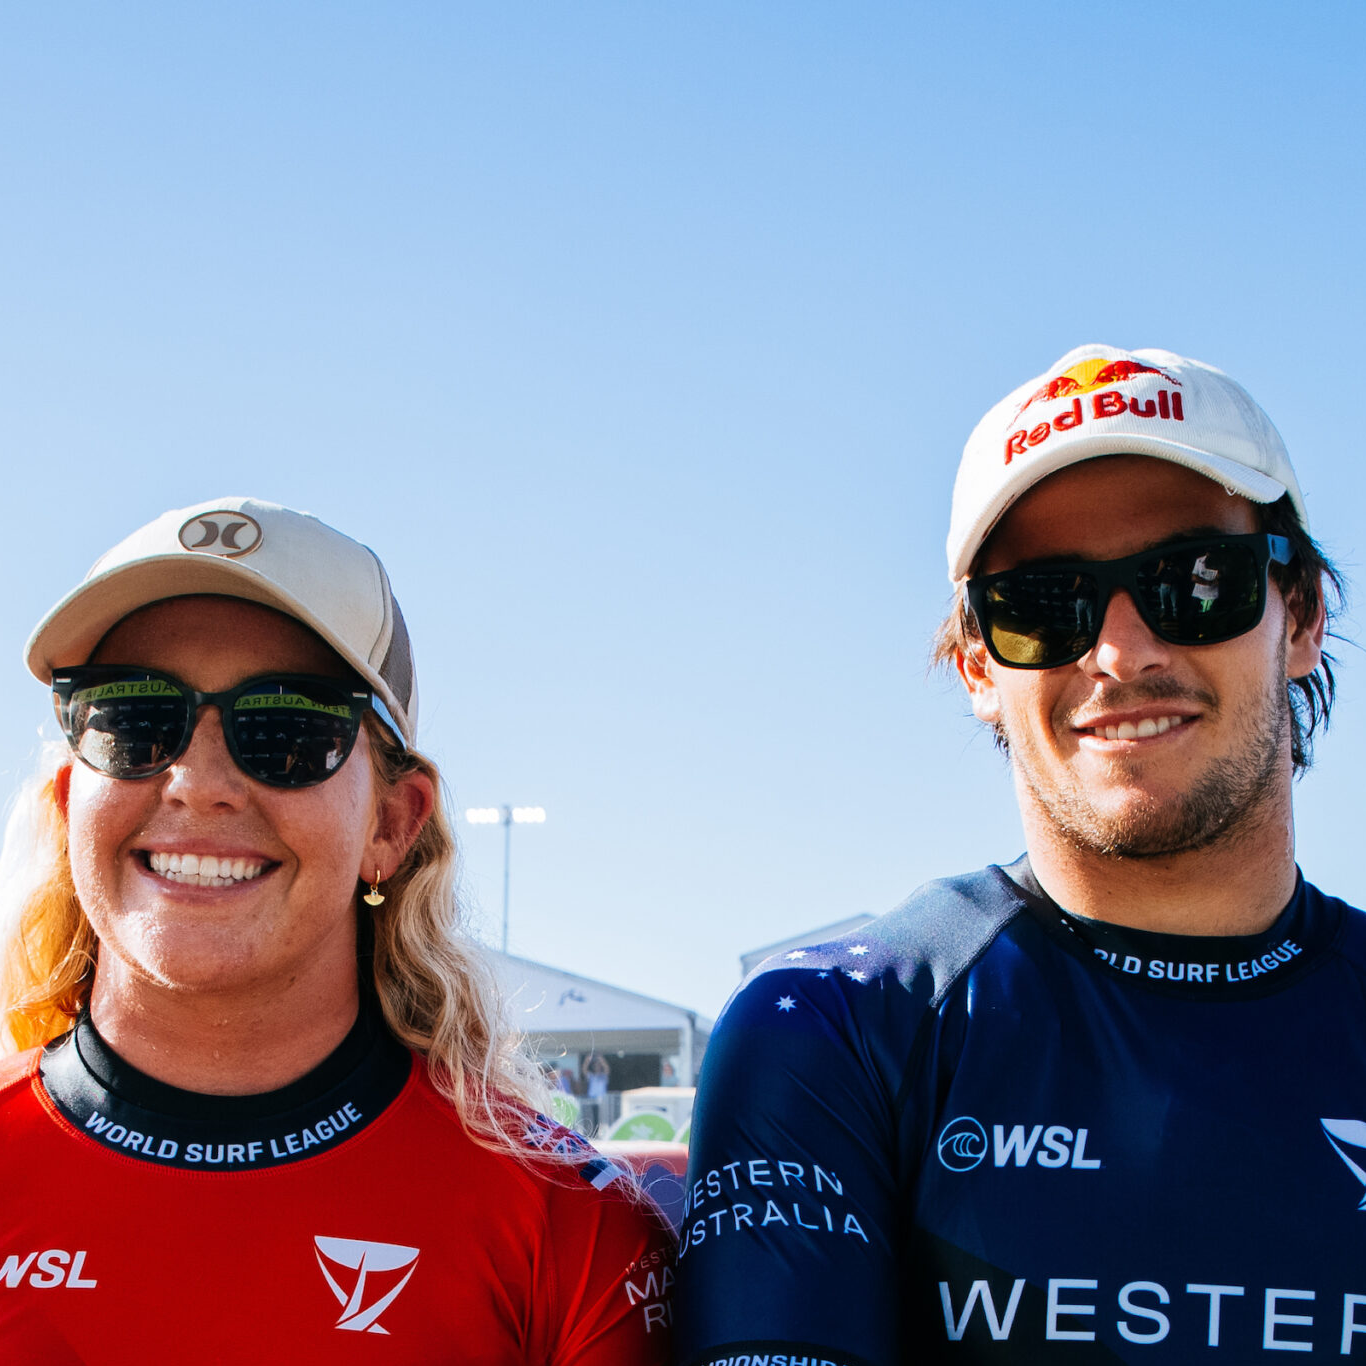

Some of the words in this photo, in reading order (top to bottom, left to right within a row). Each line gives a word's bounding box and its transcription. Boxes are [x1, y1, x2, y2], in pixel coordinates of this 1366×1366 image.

[1004, 397, 1083, 465] Red
[1093, 390, 1184, 422] Bull
[1147, 959, 1220, 983] SURF
[1225, 939, 1303, 983] LEAGUE
[85, 1111, 179, 1160] WORLD
[184, 1141, 264, 1164] SURF
[270, 1101, 363, 1159] LEAGUE
[994, 1125, 1102, 1170] WSL
[677, 1200, 869, 1262] USTRALIA
